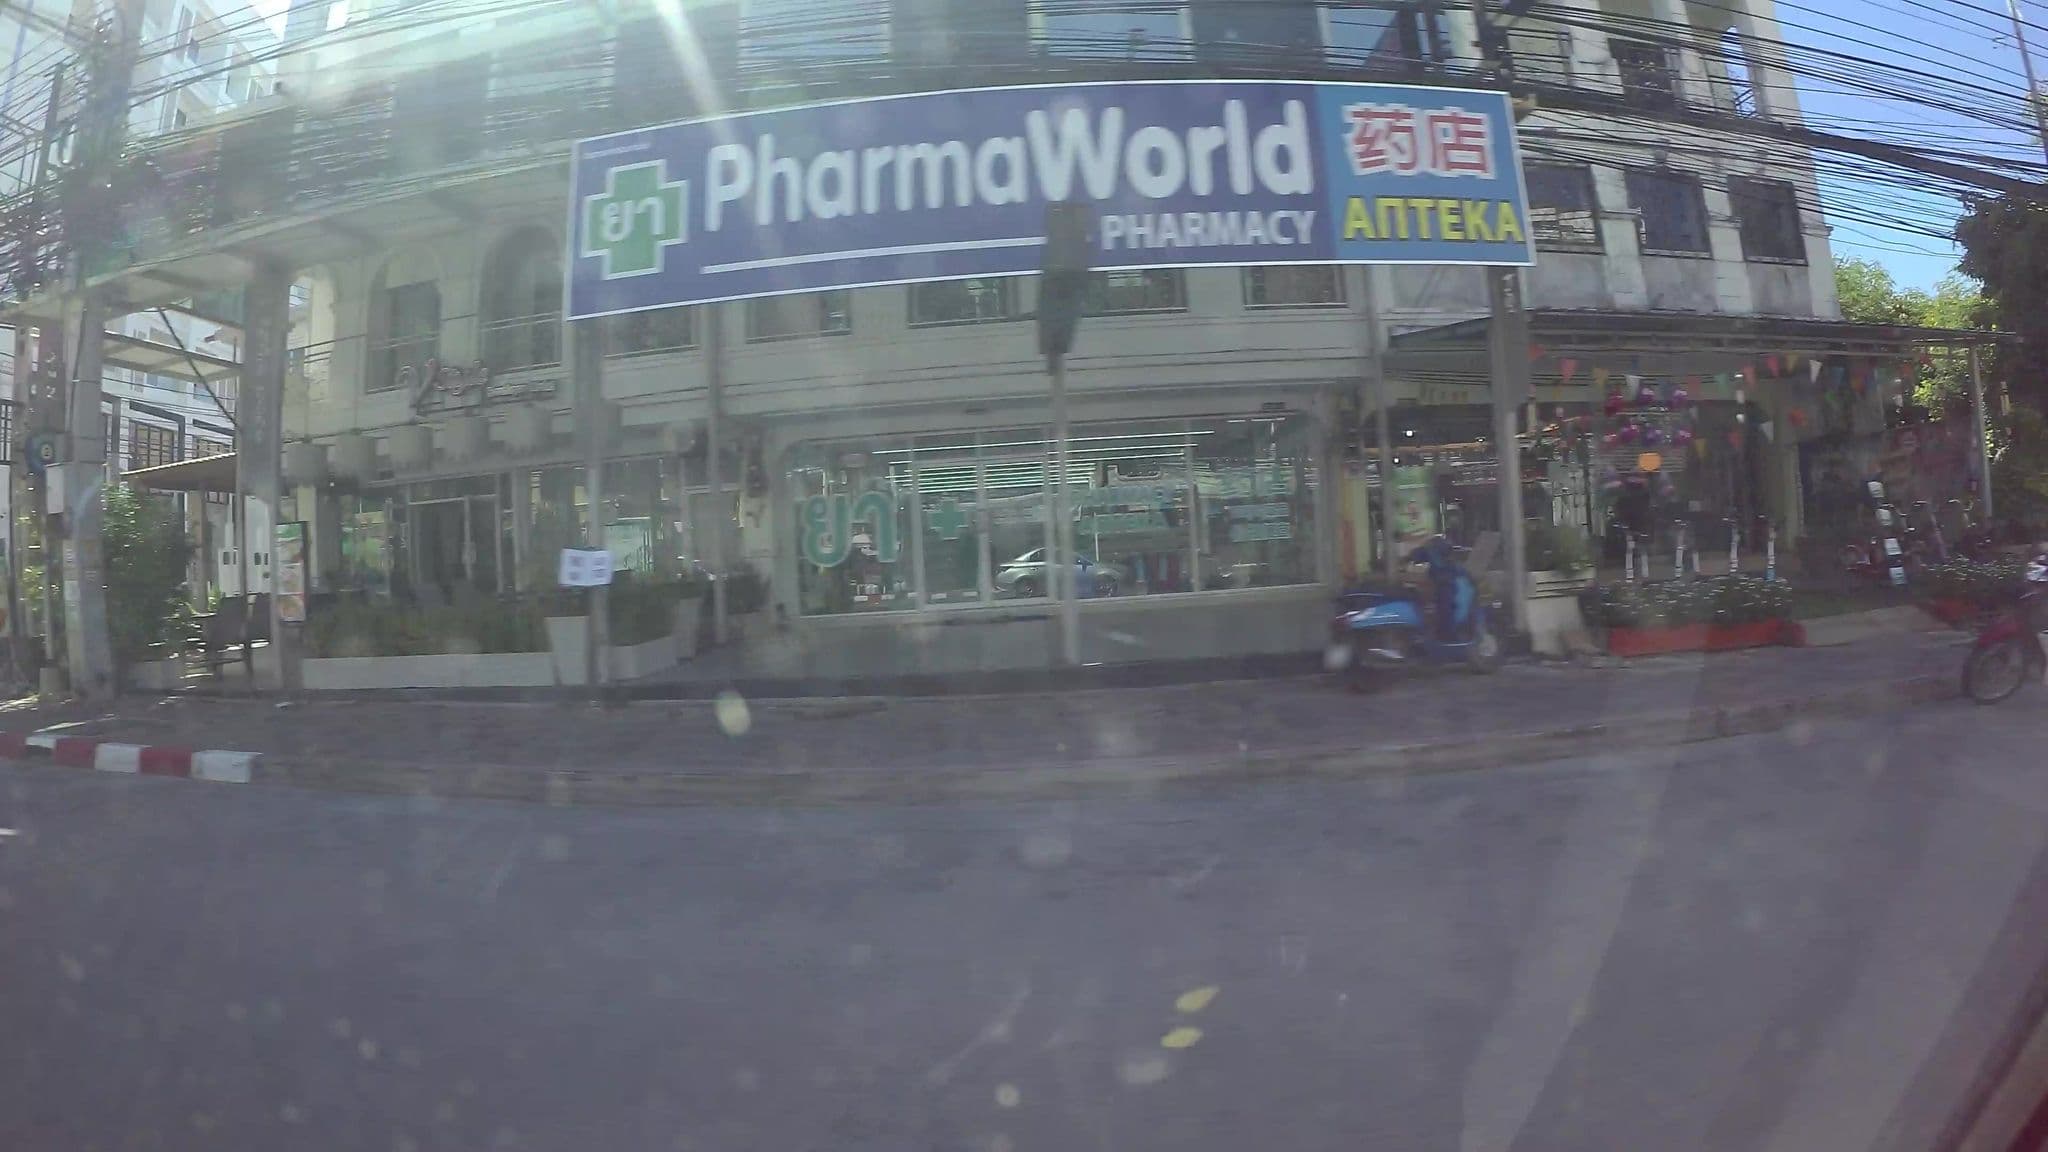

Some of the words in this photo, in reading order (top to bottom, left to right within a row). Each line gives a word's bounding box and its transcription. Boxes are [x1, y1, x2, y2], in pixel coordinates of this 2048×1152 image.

[704, 98, 1314, 232] PharmaWorld
[1345, 102, 1495, 179] 药店
[600, 196, 667, 242] ยา
[1101, 209, 1317, 250] PHARMACY
[1343, 196, 1526, 244] АПТЕКА
[799, 491, 902, 568] ยา
